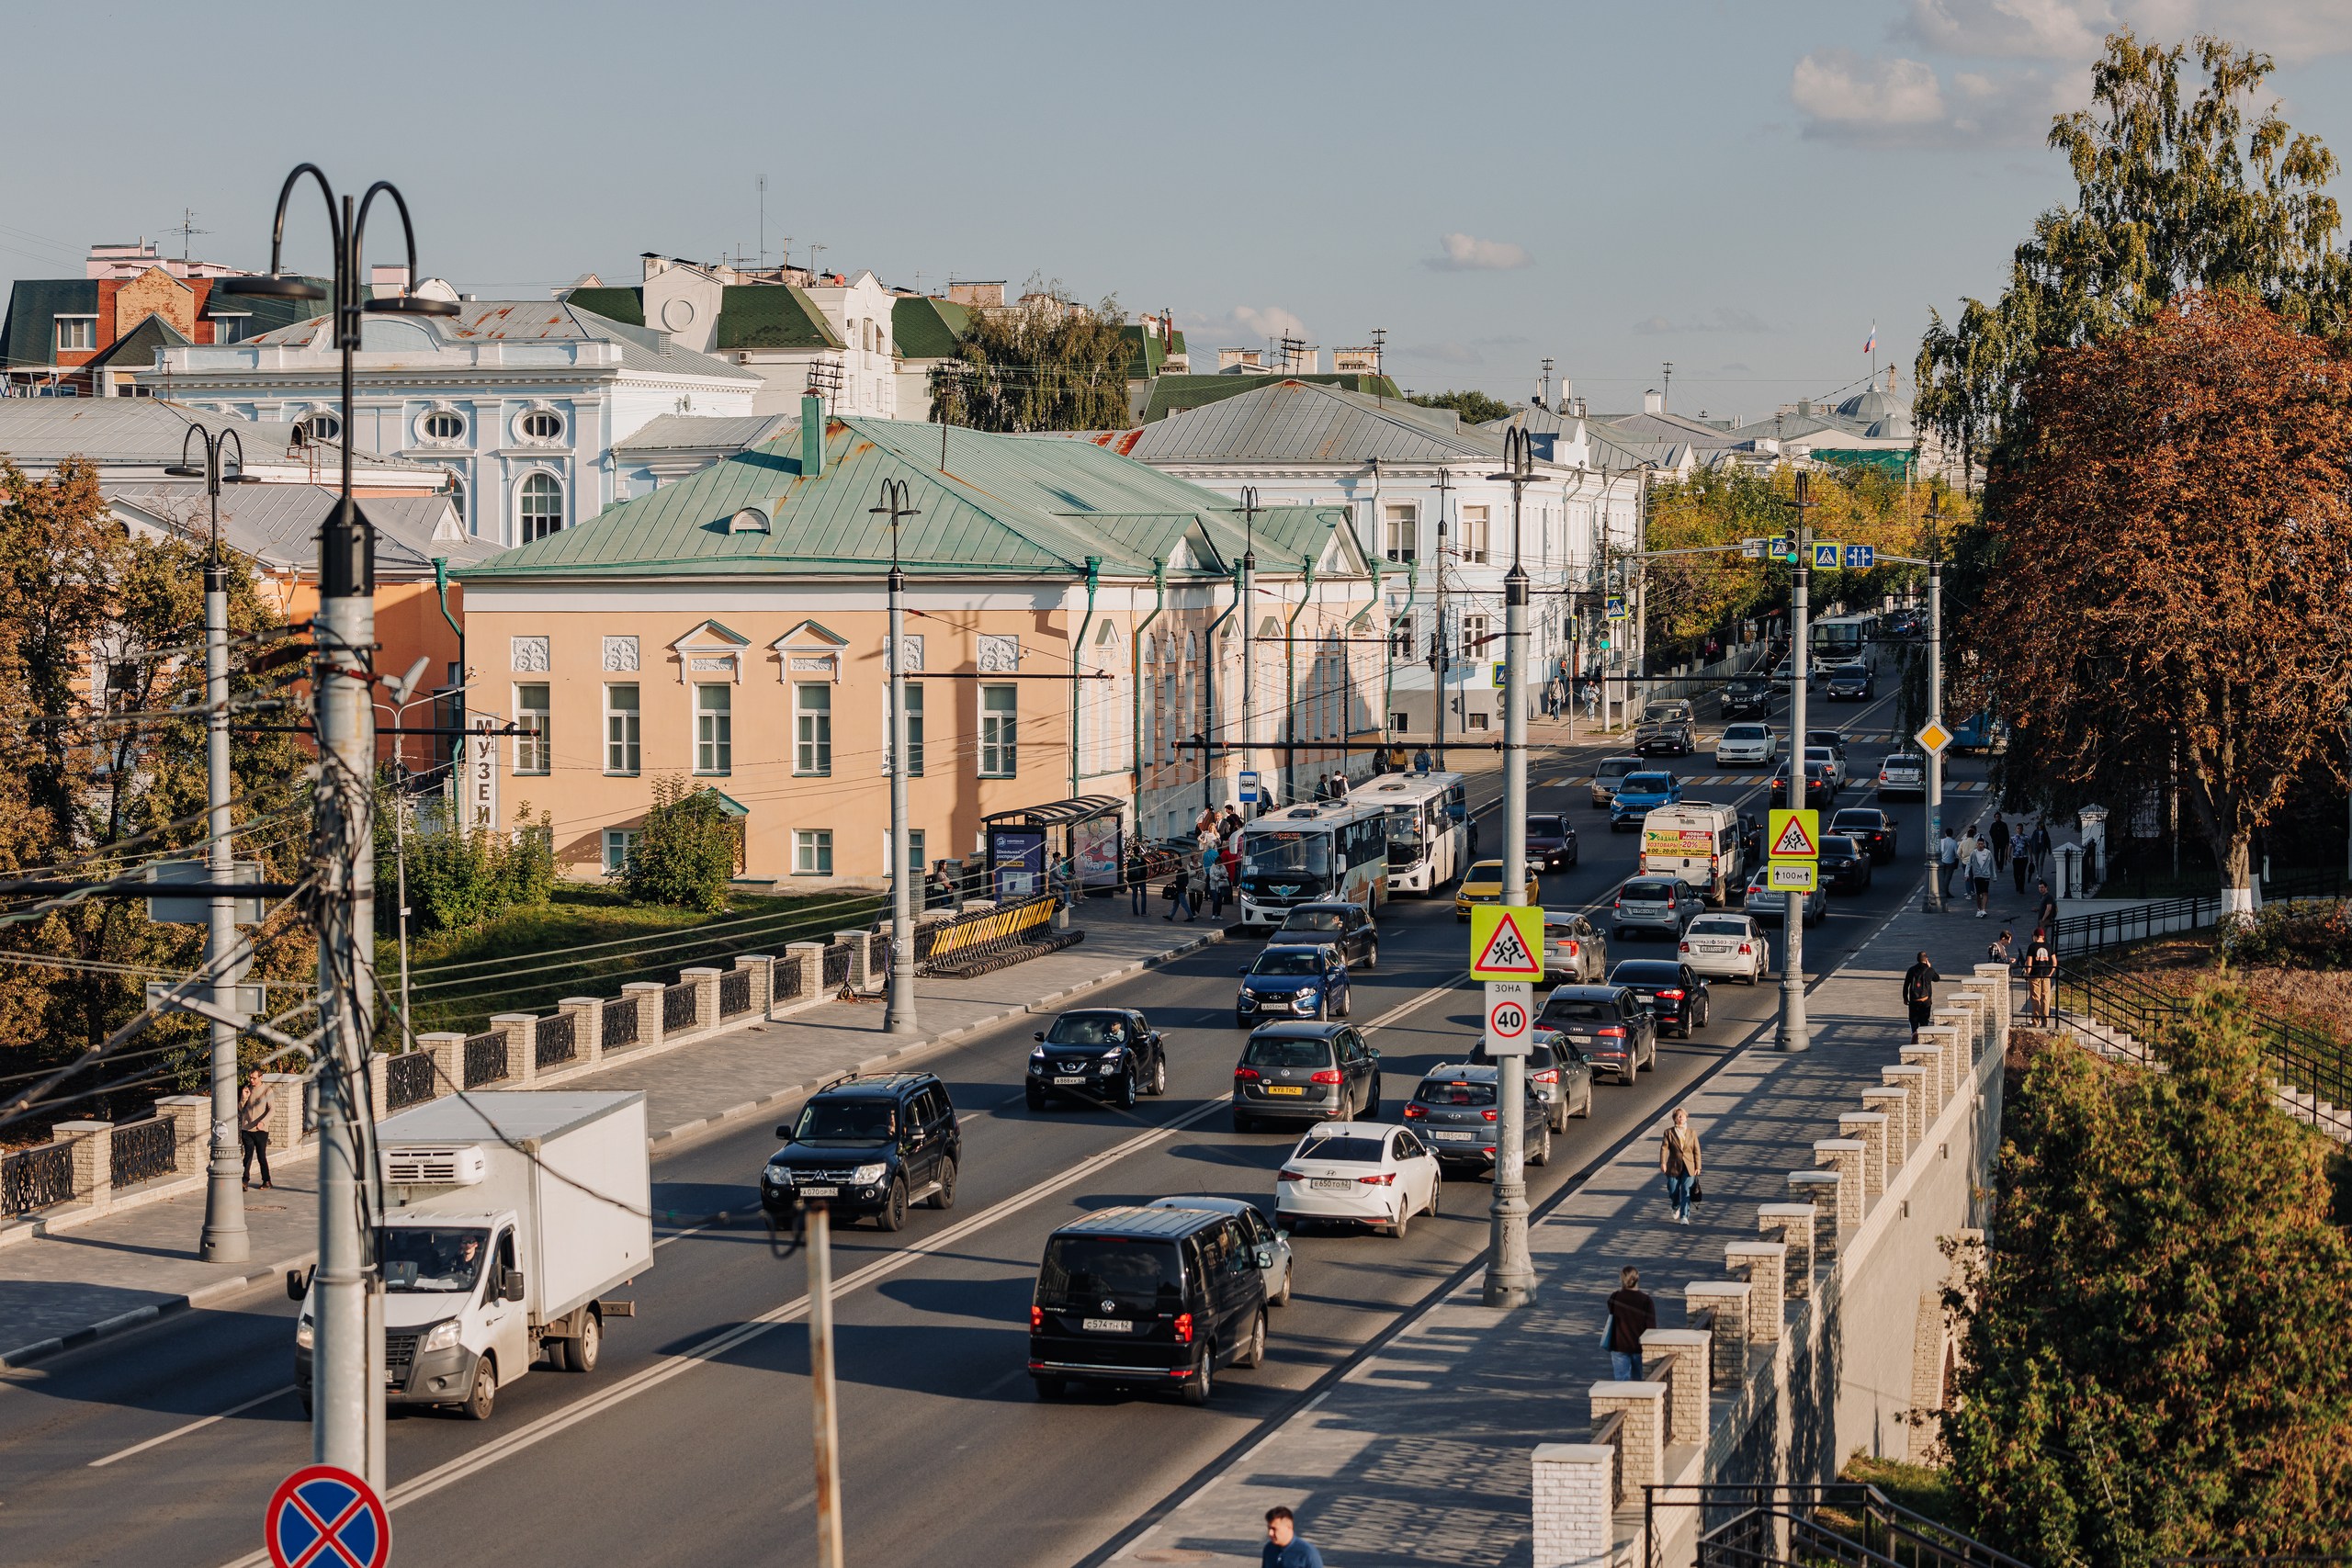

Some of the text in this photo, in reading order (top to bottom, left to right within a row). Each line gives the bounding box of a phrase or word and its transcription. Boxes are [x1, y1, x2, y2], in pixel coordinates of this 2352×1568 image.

[476, 719, 492, 824] МУЗЕЙ
[1495, 984, 1521, 992] ЗОНА
[1498, 1011, 1521, 1028] 40
